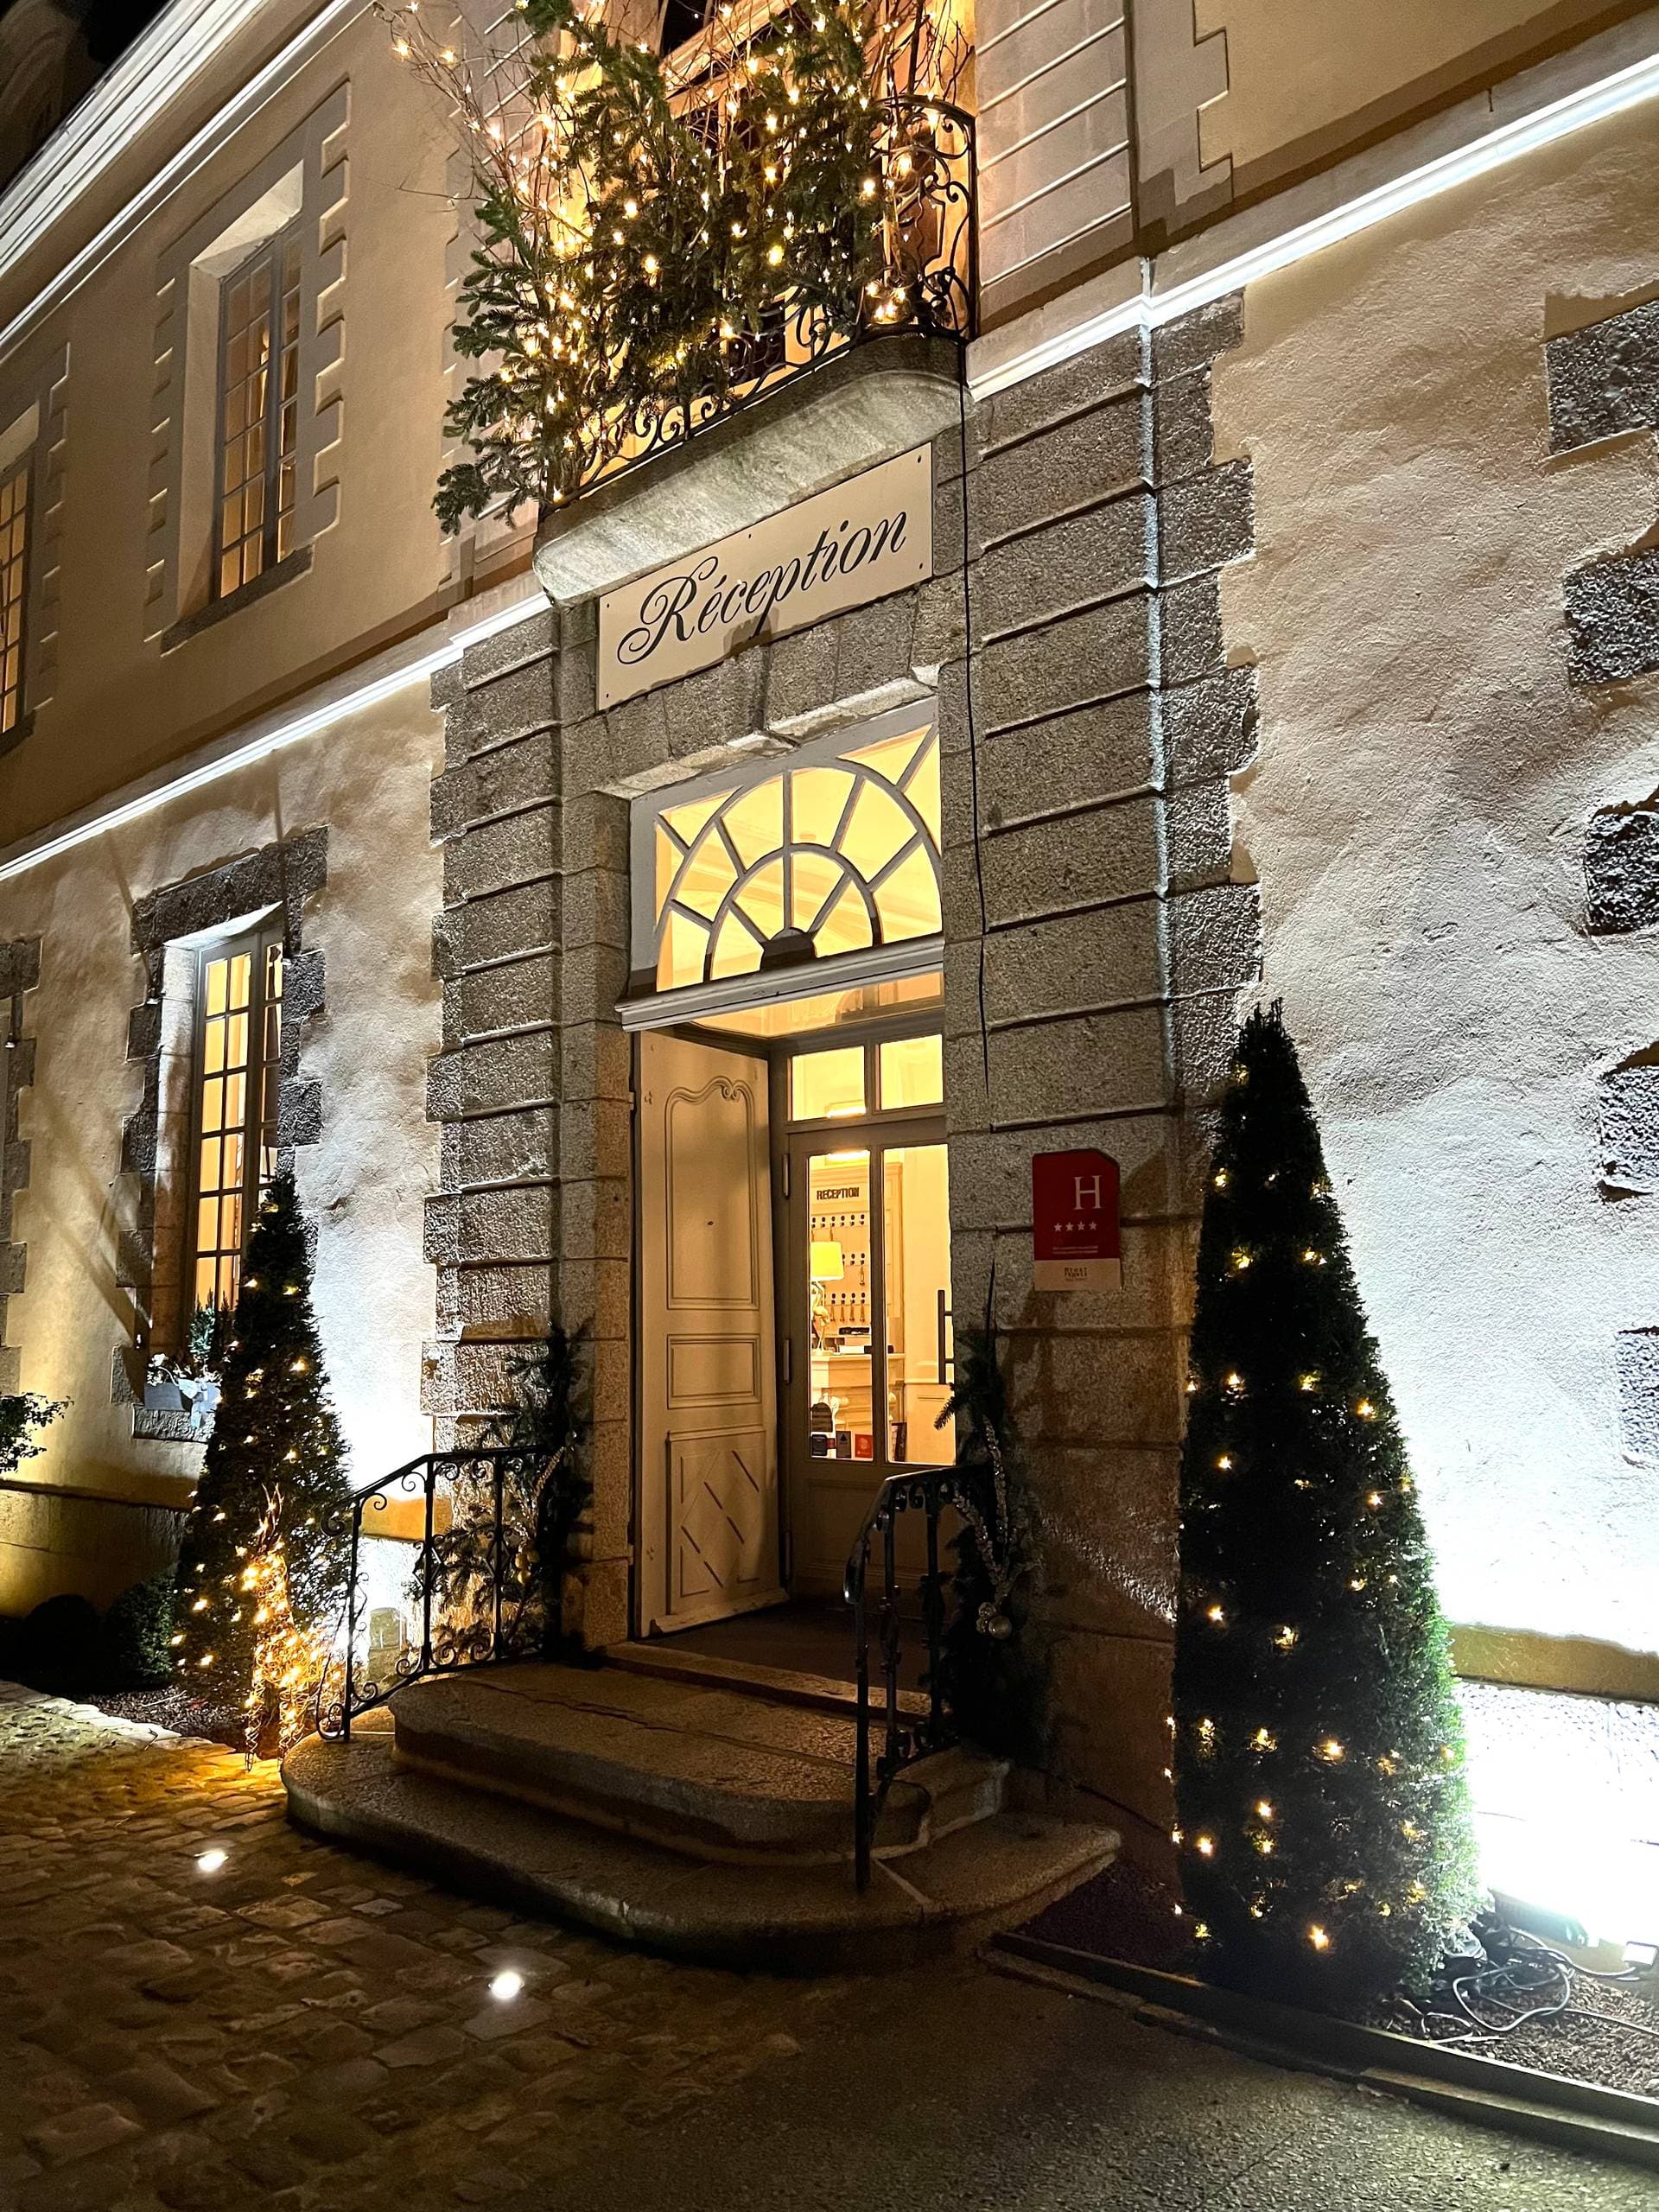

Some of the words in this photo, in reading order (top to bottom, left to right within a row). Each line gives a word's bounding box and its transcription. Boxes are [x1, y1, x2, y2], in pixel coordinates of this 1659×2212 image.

[617, 511, 907, 665] Réception
[817, 1187, 860, 1200] RECEPTION
[1073, 1174, 1102, 1211] H
